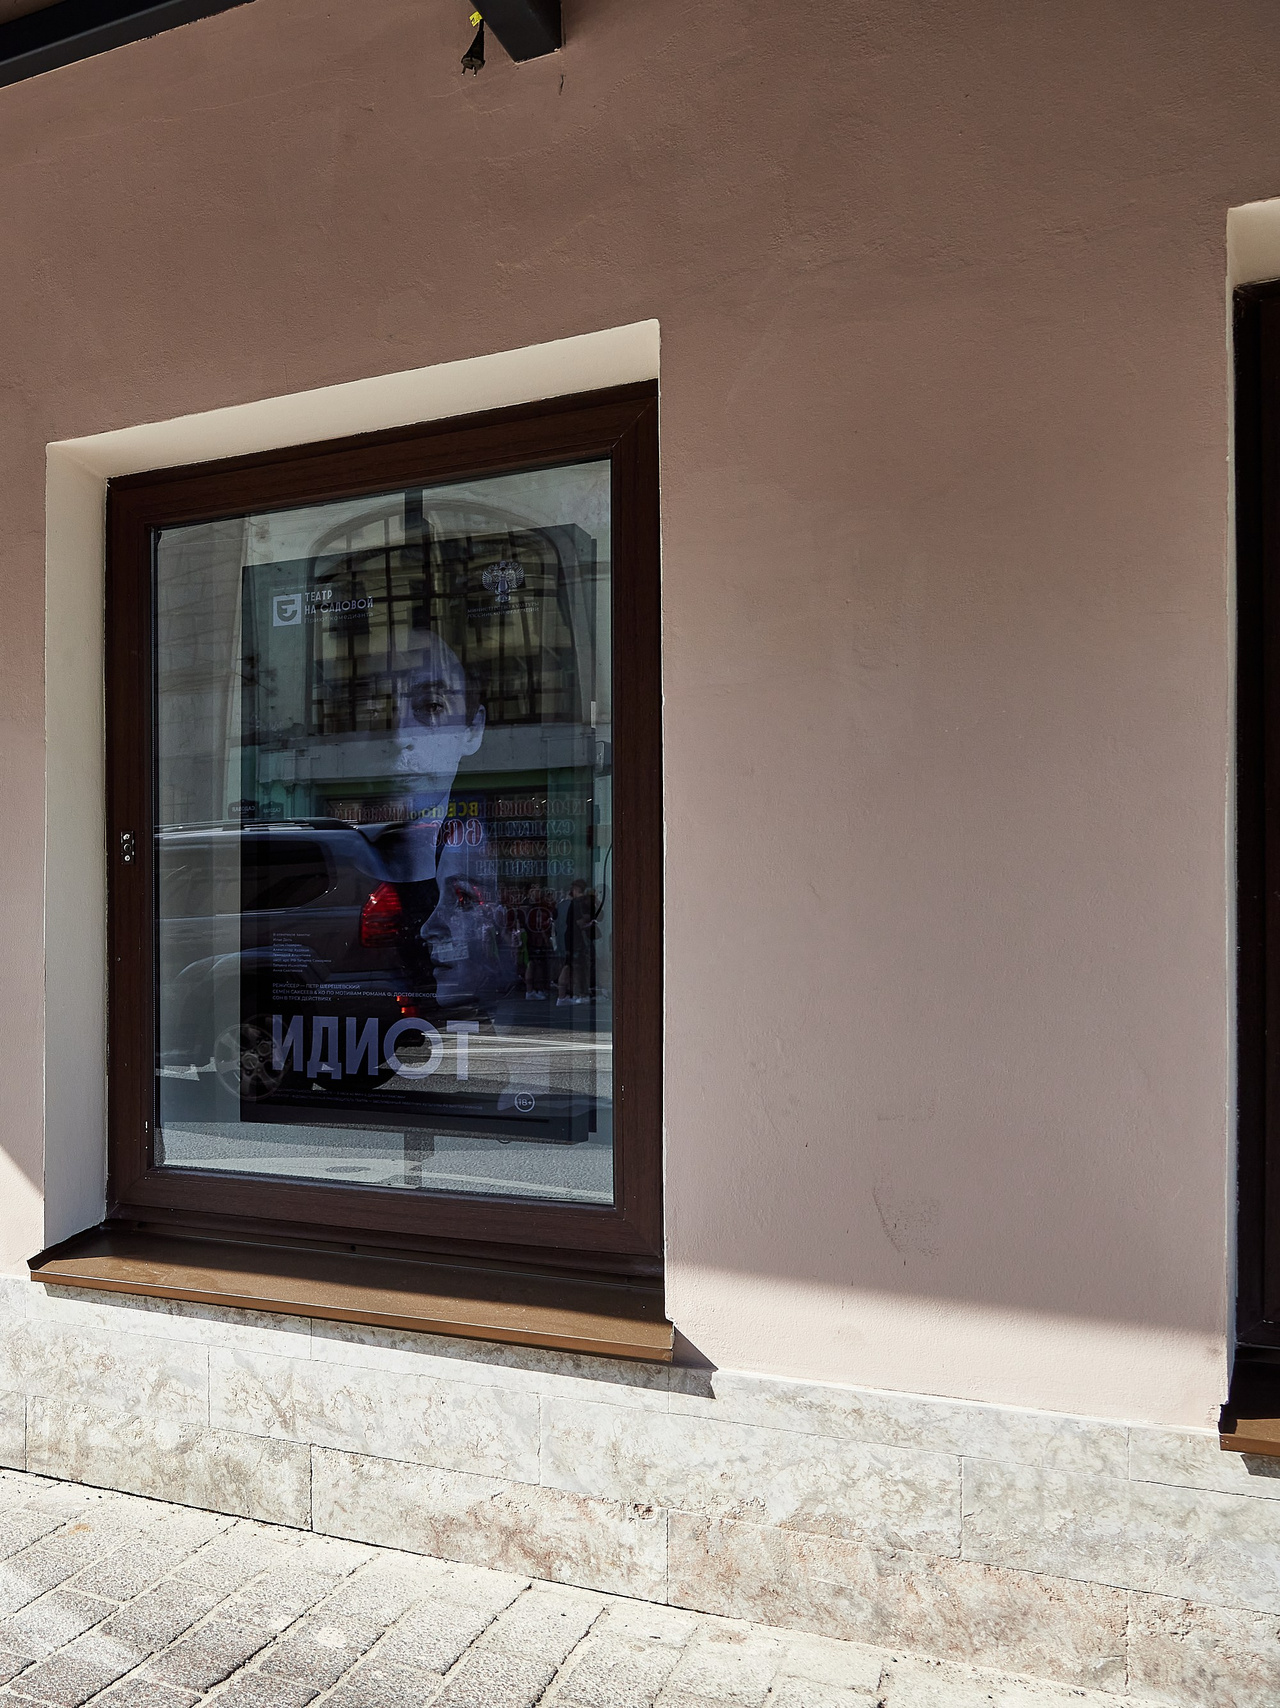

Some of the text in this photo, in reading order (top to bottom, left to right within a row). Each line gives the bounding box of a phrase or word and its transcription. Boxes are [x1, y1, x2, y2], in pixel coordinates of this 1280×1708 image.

[304, 595, 374, 615] НА САДОВОЙ
[305, 589, 333, 602] ТЕАТР
[271, 1014, 480, 1082] ИДИОТ
